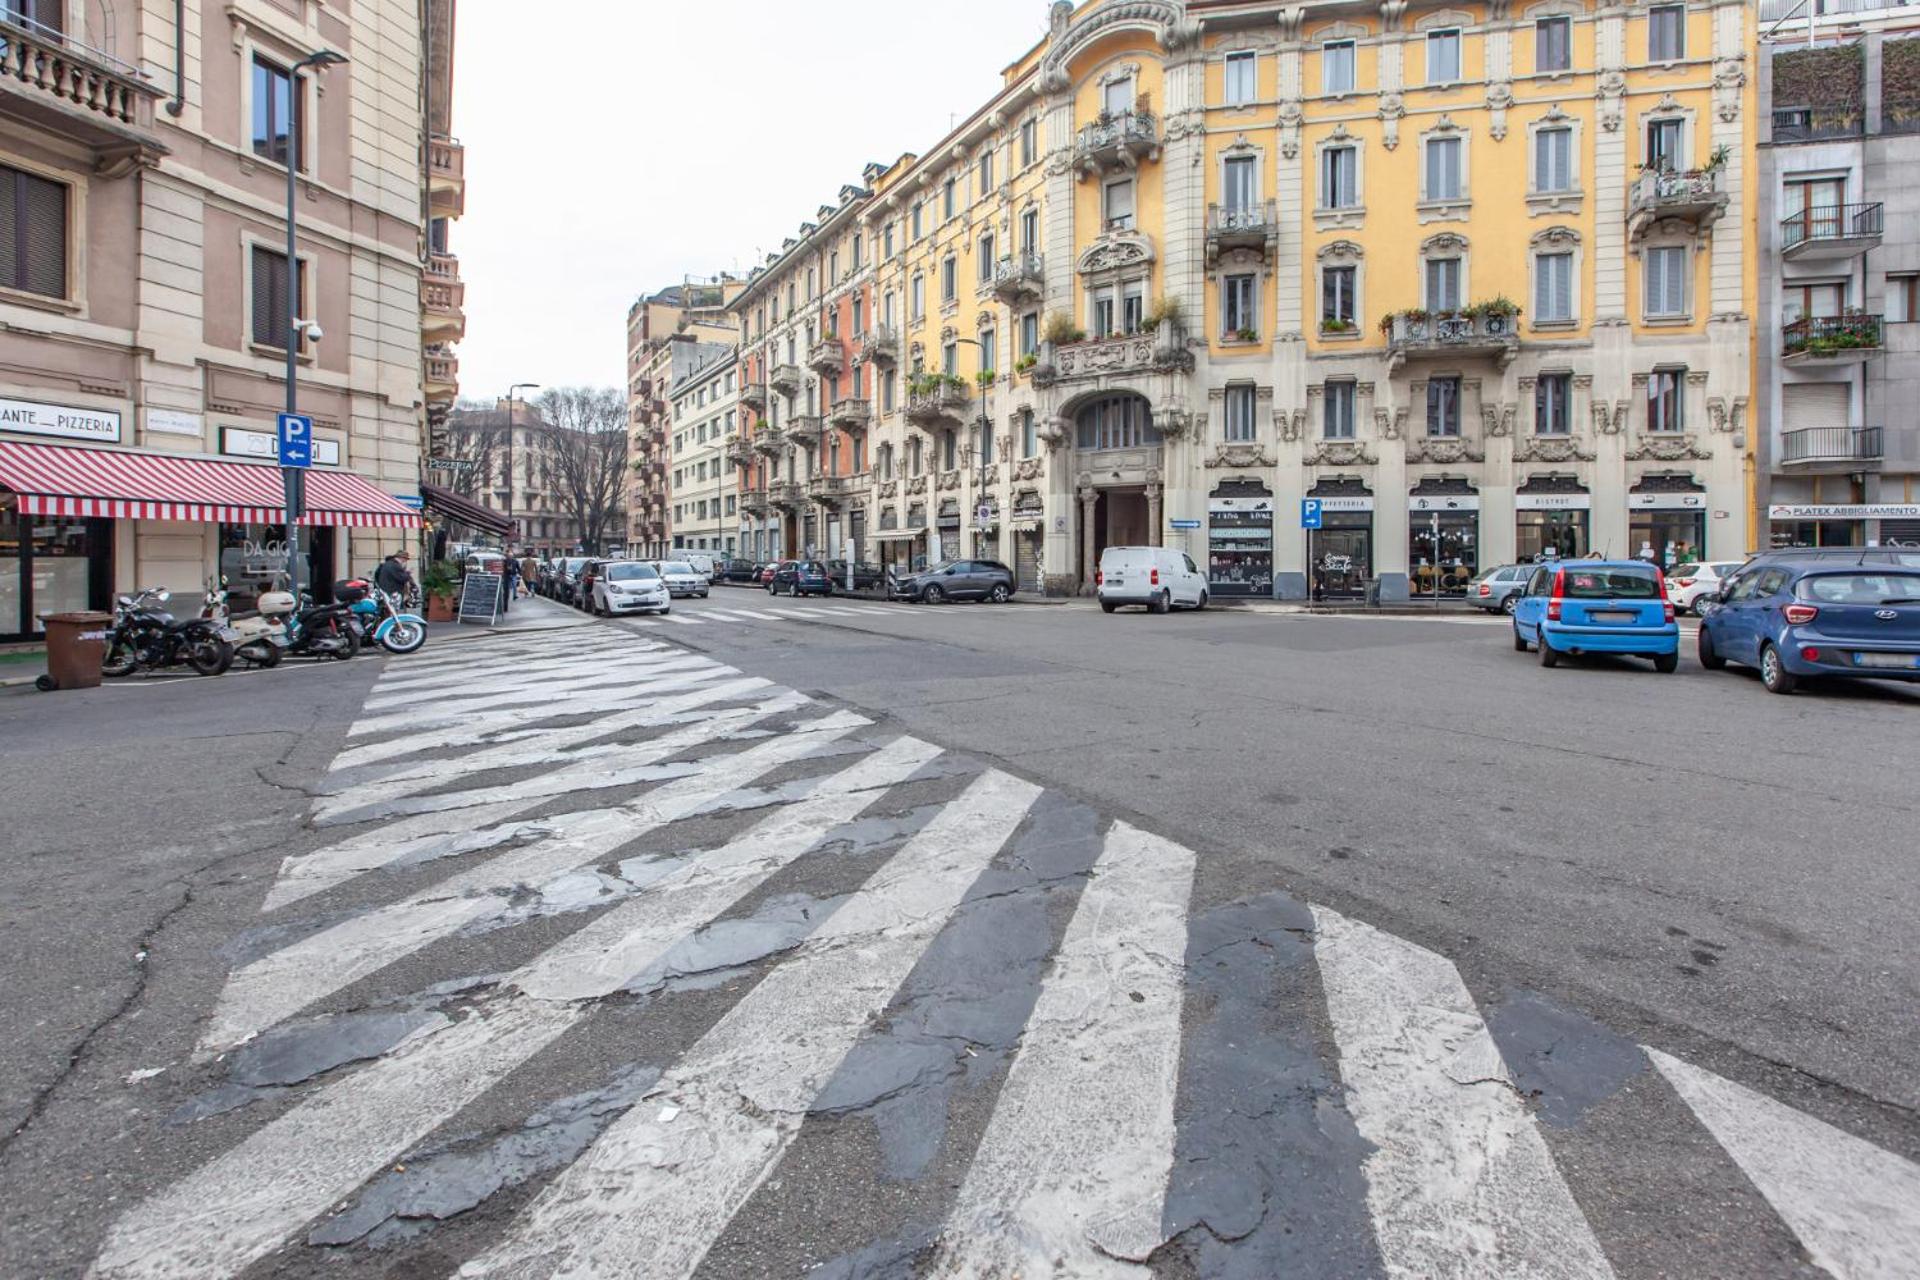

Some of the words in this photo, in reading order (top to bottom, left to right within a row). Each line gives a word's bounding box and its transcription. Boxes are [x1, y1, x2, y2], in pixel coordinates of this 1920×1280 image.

[57, 414, 113, 432] PIZZERIA
[285, 417, 304, 442] P
[1305, 501, 1317, 516] P
[1794, 507, 1830, 515] PLATEX
[1833, 507, 1917, 515] ABBIGLIAMENTO
[243, 540, 264, 557] DA
